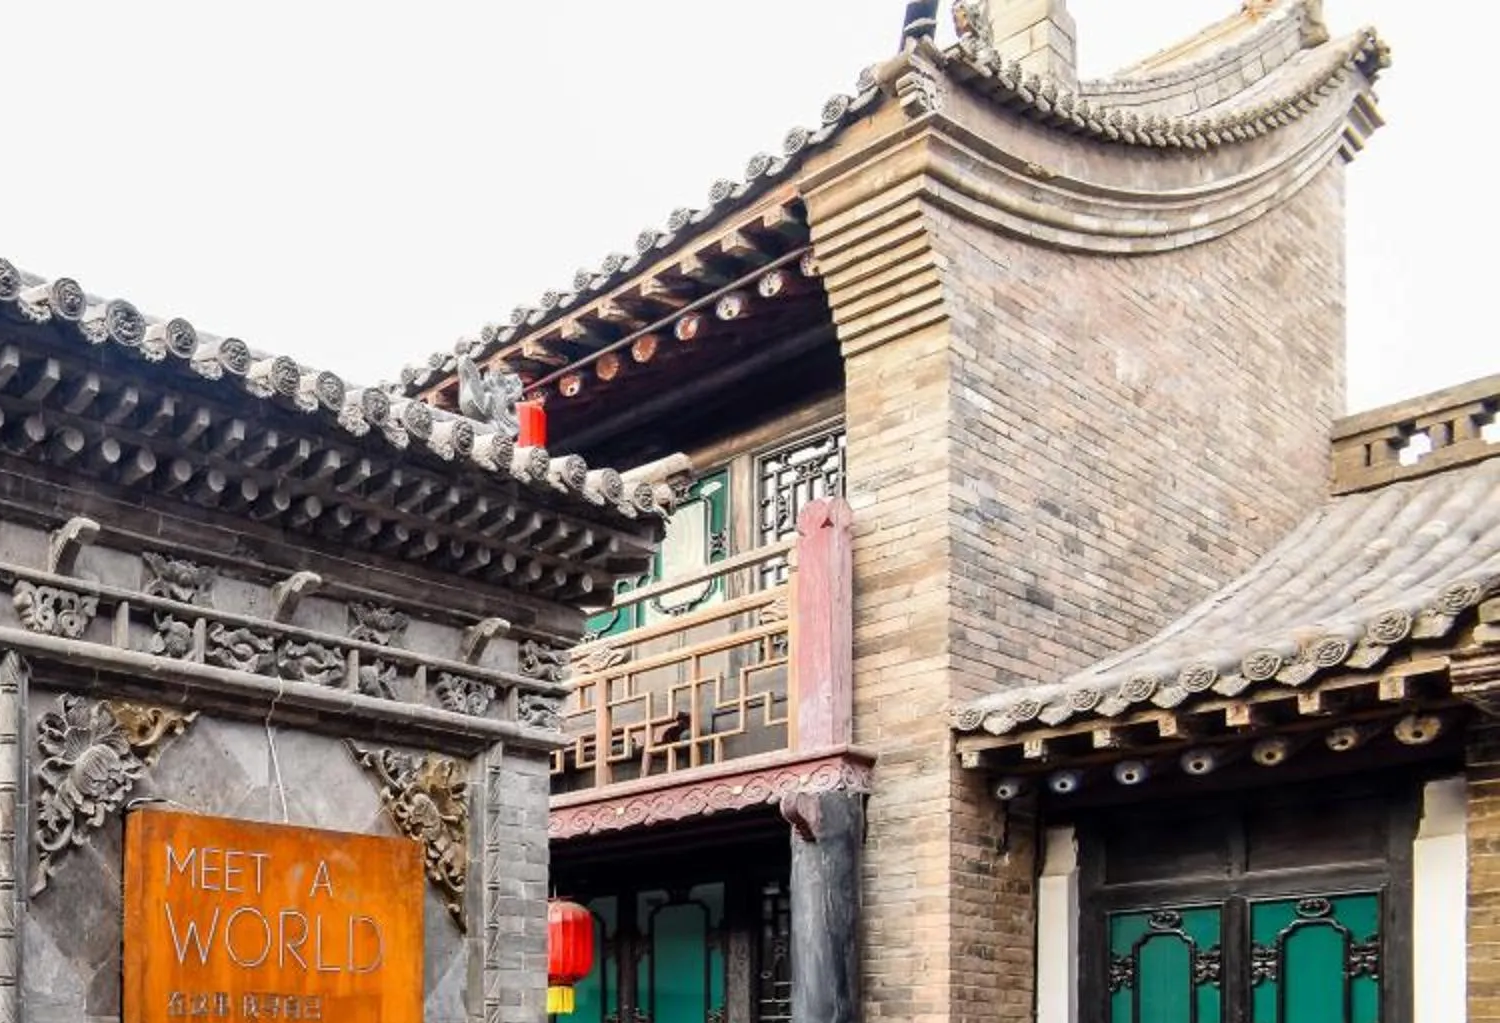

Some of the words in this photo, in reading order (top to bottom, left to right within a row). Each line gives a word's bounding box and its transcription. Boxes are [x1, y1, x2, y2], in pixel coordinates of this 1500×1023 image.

[165, 844, 270, 894] MEET
[309, 859, 334, 898] A
[165, 901, 385, 974] WORLD
